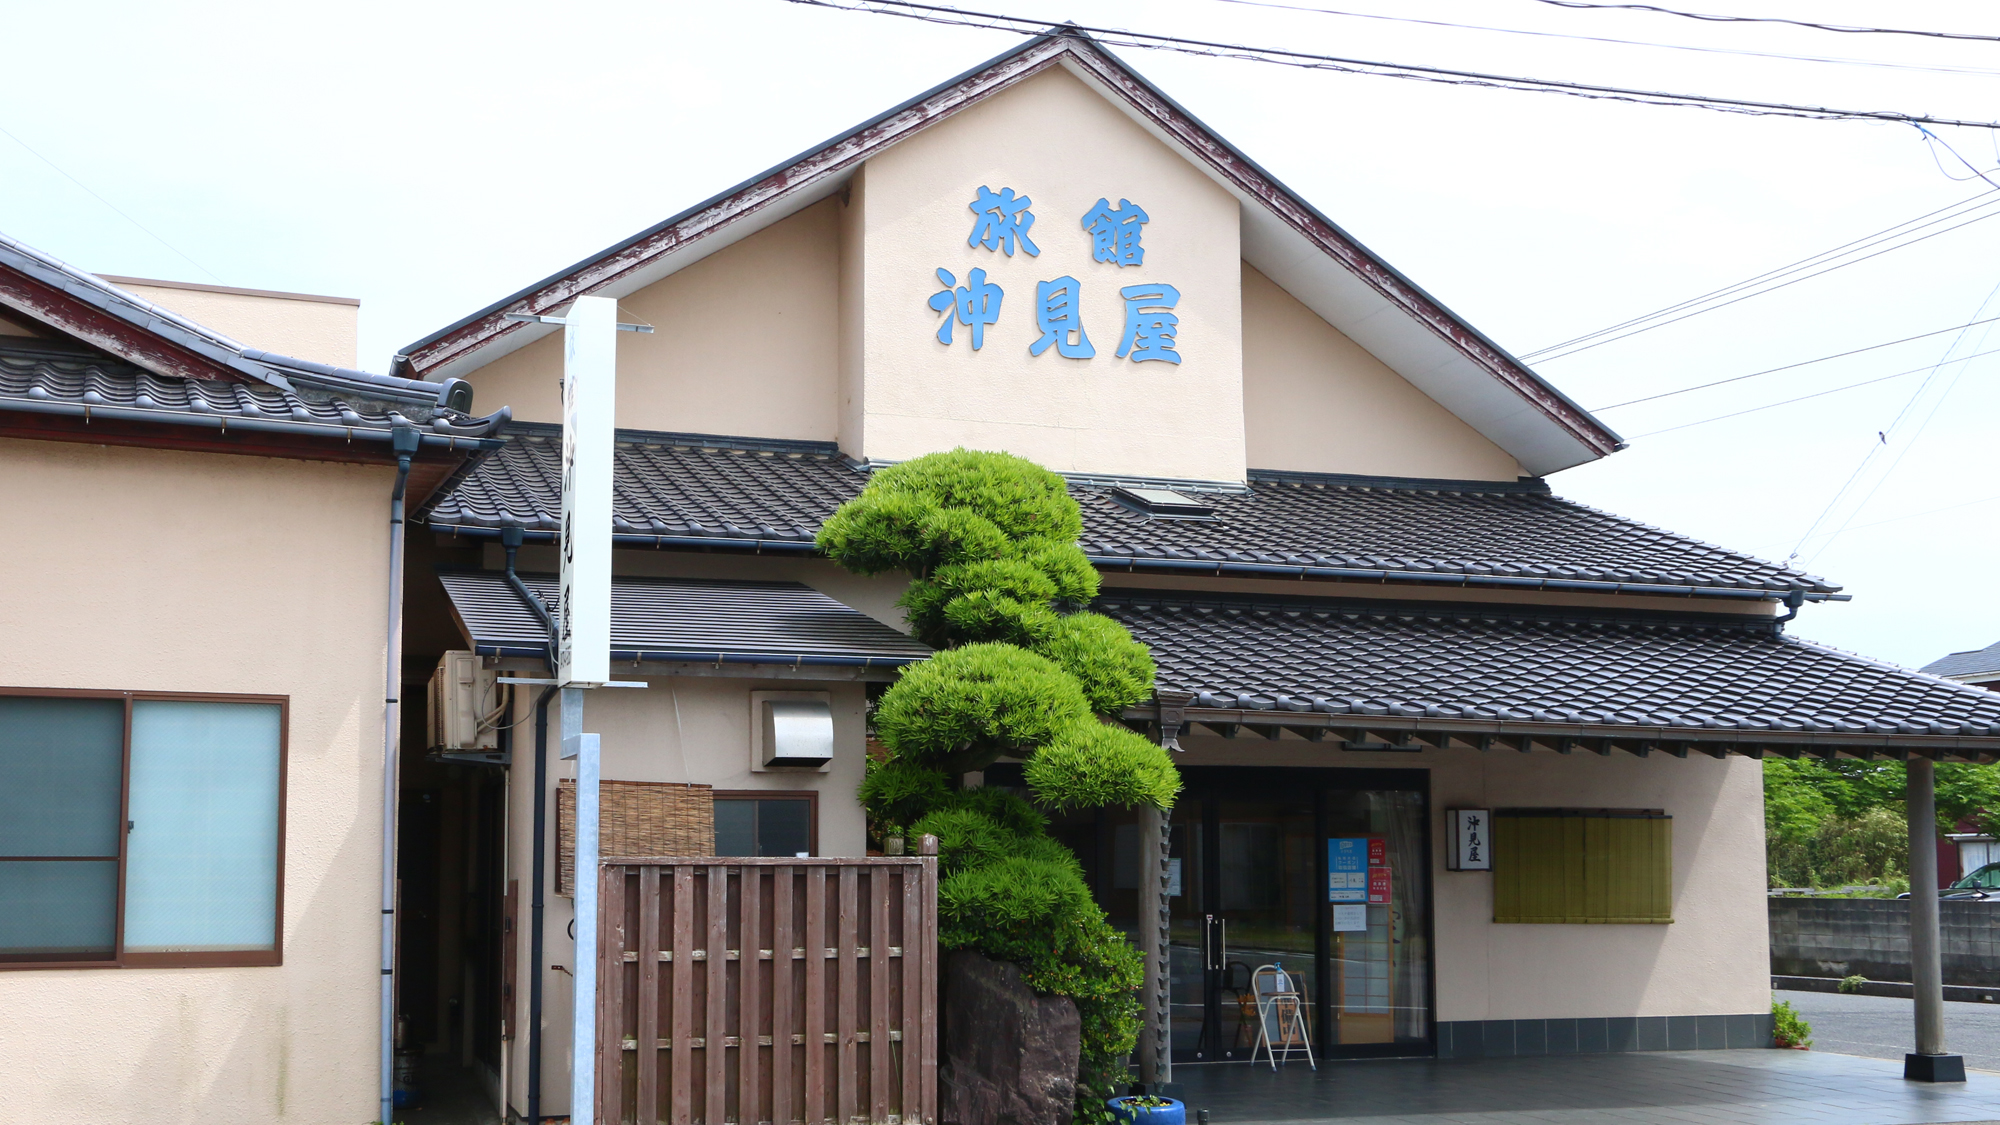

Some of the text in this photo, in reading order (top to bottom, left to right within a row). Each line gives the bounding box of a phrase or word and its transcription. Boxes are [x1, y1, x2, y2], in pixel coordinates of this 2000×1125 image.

[968, 184, 1150, 267] 旅館
[928, 267, 1182, 365] 沖見屋
[1467, 815, 1481, 862] 沖見屋
